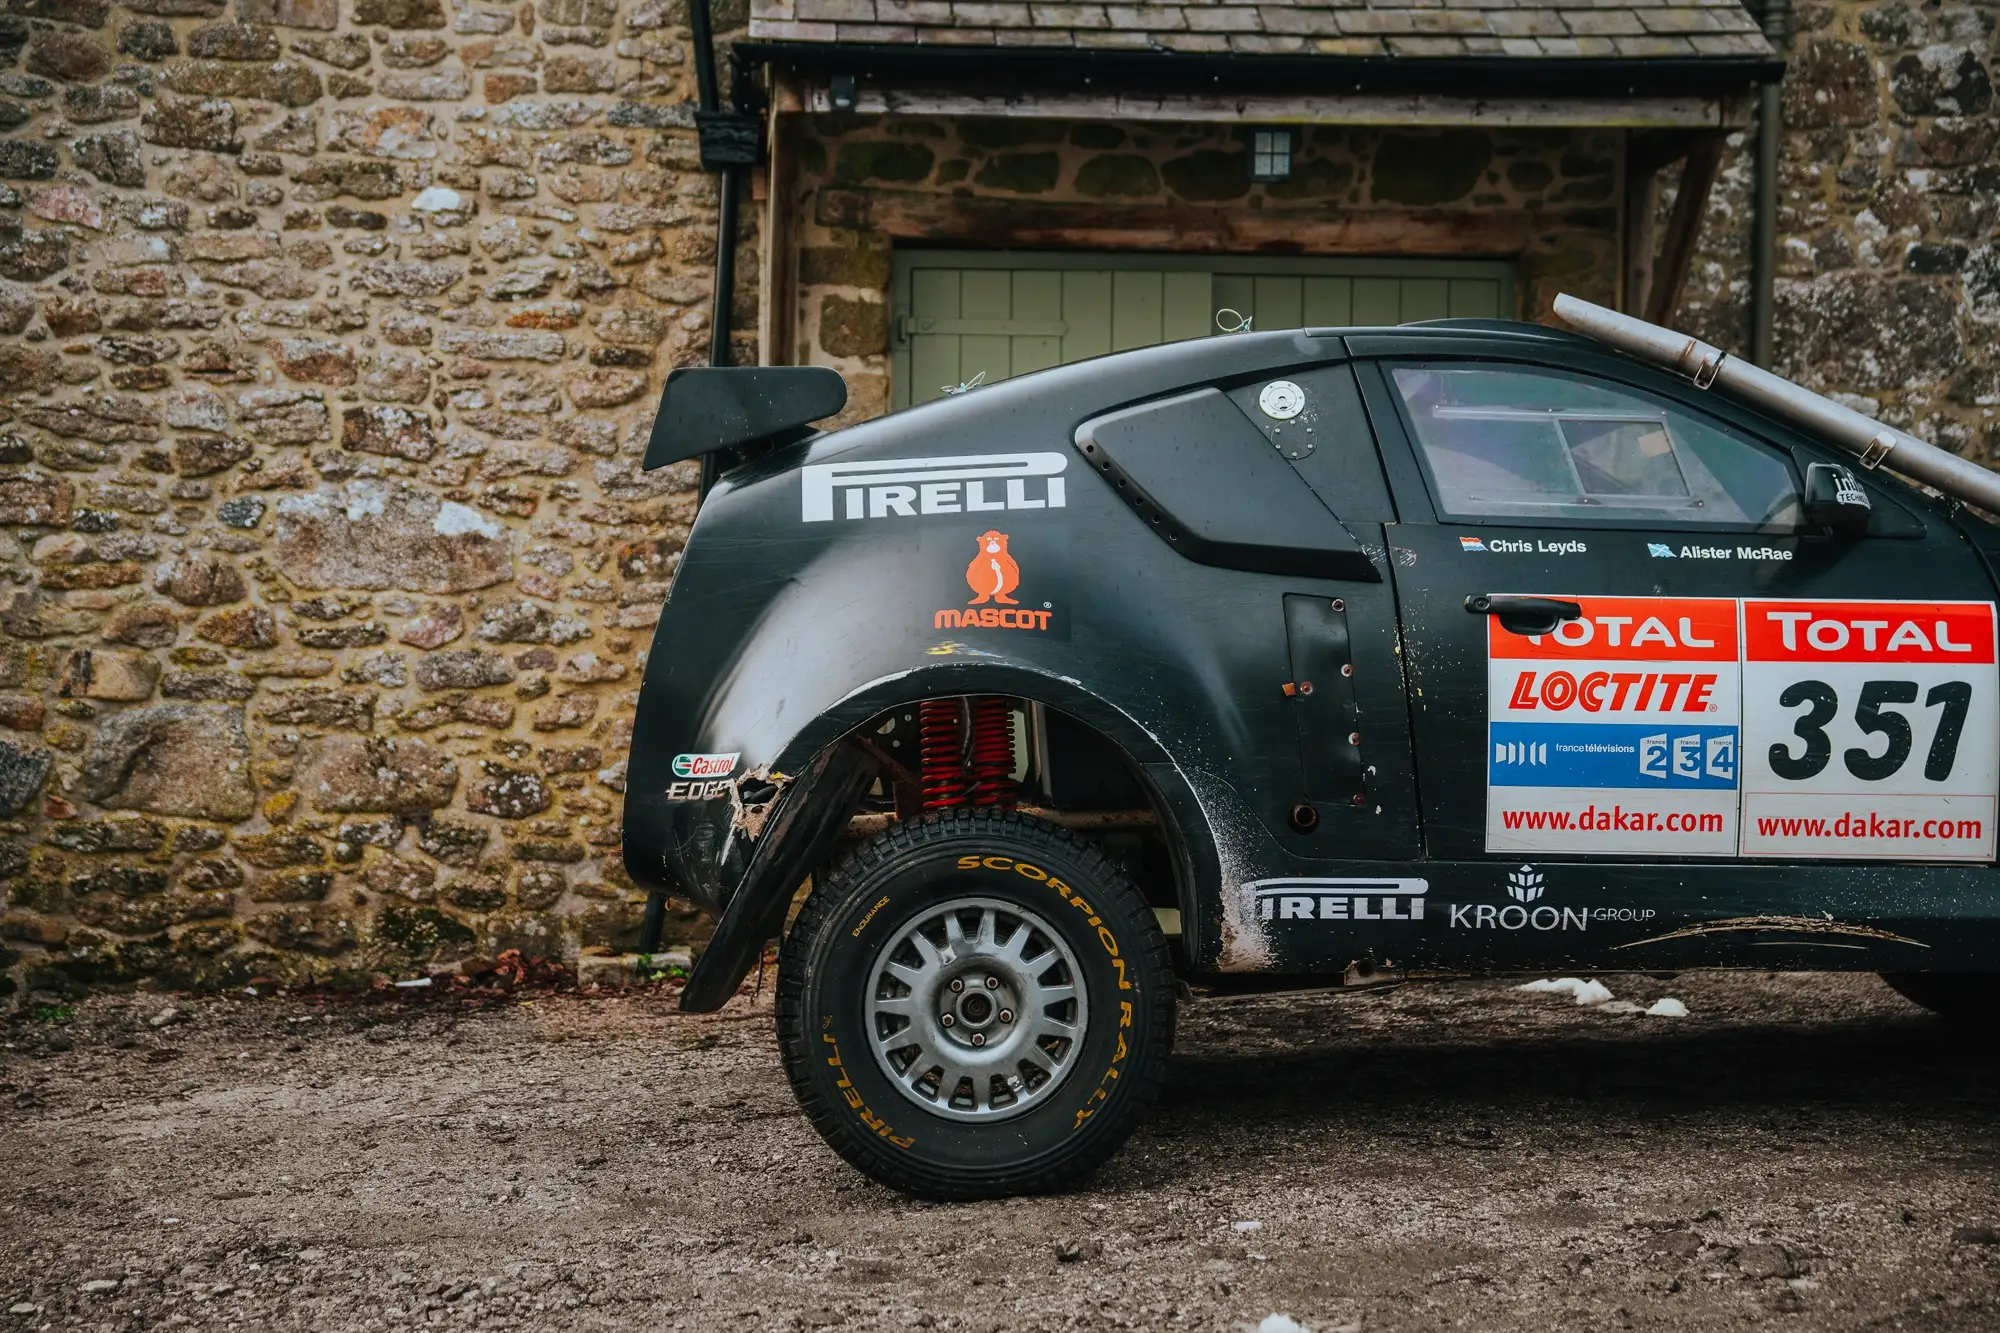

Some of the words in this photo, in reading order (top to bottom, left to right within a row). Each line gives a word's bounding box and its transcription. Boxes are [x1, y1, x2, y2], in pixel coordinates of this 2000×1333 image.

[802, 452, 1067, 522] PIRELLI
[1490, 539, 1533, 553] Chris
[1538, 540, 1587, 556] Leyds
[1680, 545, 1732, 559] Alister
[1737, 547, 1793, 561] McRae
[934, 608, 1052, 630] MASCOT
[1528, 616, 1715, 648] OTAL
[1767, 612, 1972, 652] TOTAL
[1508, 671, 1718, 712] LOCTITE
[1768, 680, 1972, 782] 351
[692, 756, 735, 775] Castrol
[1646, 746, 1667, 771] 2
[1679, 746, 1700, 771] 3
[1711, 746, 1733, 772] 4
[1503, 805, 1724, 832] www.dakar.com
[1757, 812, 1982, 839] www.dakar.com
[852, 896, 890, 937] ENDURANCE
[1450, 904, 1588, 931] KROON
[1593, 907, 1656, 921] GROUP
[957, 855, 1136, 991] SCORPION
[1071, 1000, 1132, 1131] RALLY
[823, 1033, 916, 1149] PIRELLI
